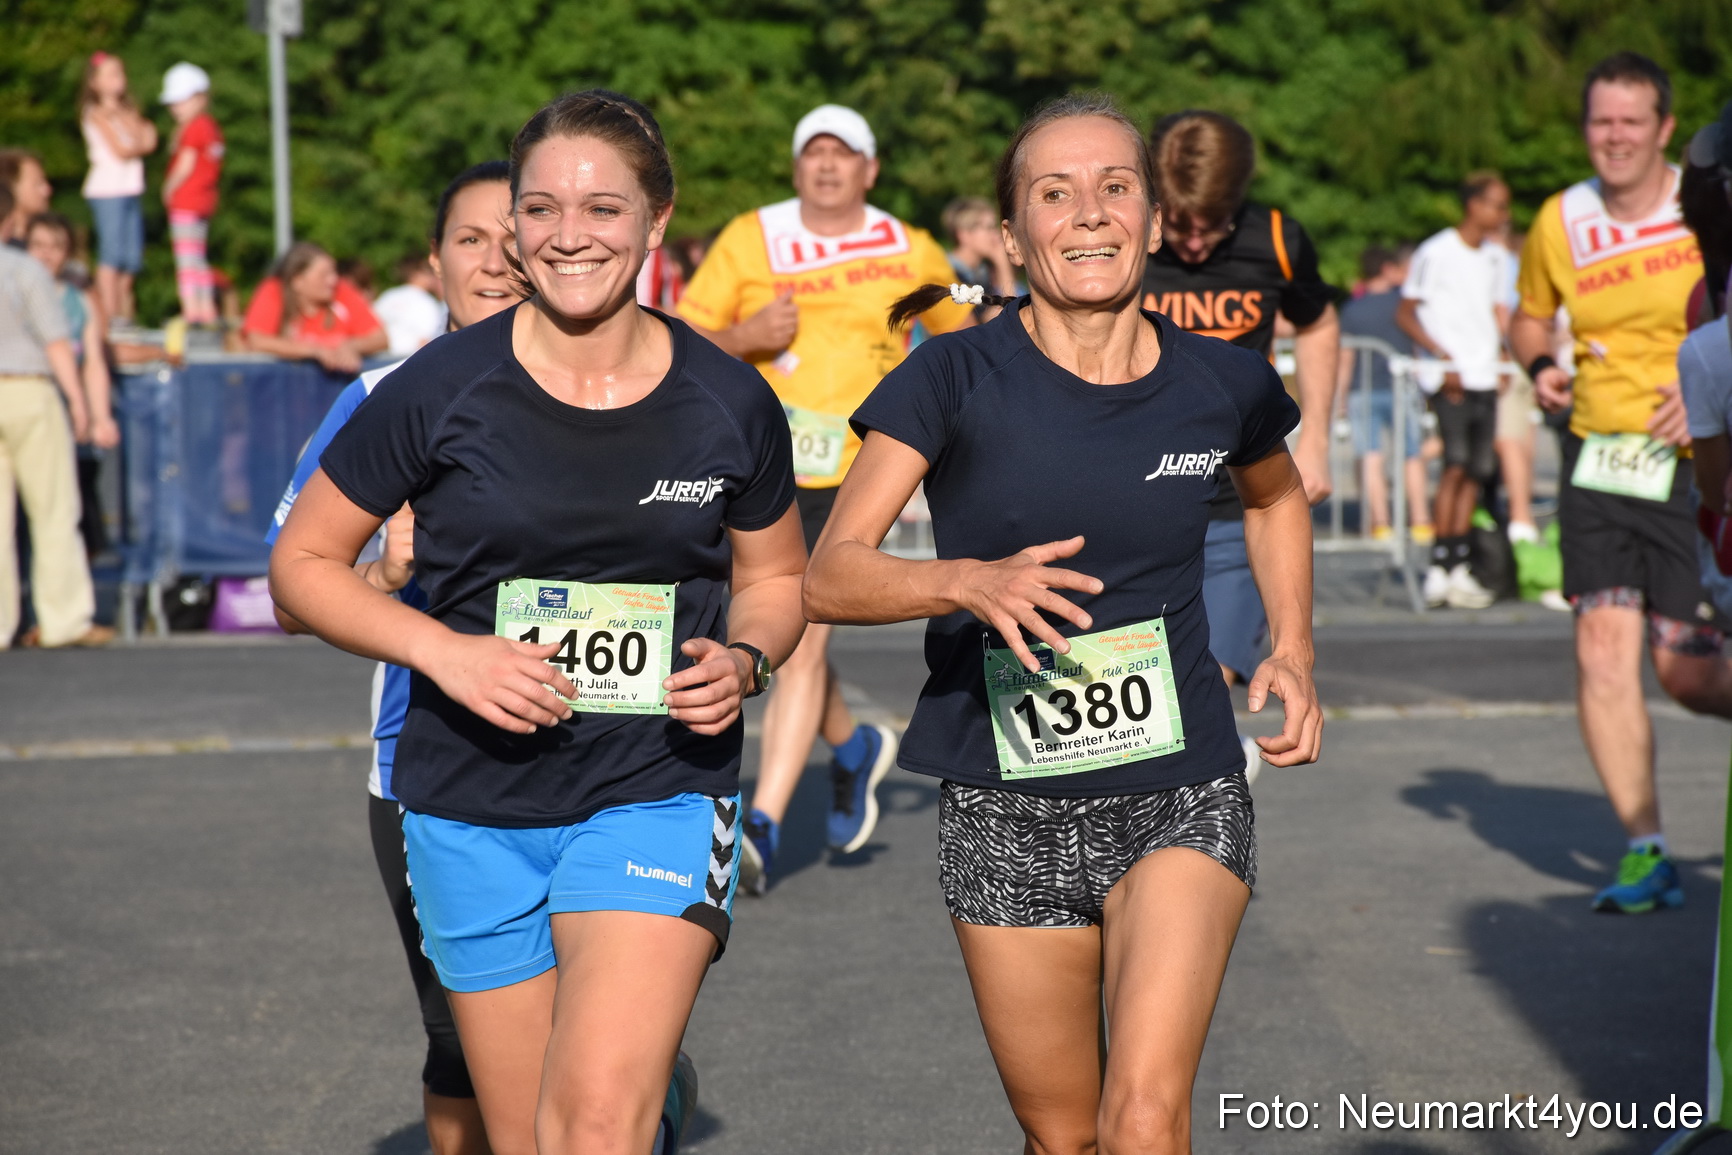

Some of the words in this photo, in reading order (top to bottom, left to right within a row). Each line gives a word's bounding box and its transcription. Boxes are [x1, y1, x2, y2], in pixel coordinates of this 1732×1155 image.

[773, 275, 836, 297] MAX
[845, 262, 915, 285] BÖGL
[1576, 264, 1633, 297] MAX
[1643, 246, 1704, 276] BÖG
[792, 430, 830, 460] 03
[1145, 453, 1210, 481] JURA
[1594, 447, 1660, 478] 1640
[638, 480, 708, 505] JURA
[524, 603, 594, 620] firmenlauf
[631, 619, 662, 630] 2019
[1012, 662, 1083, 686] firmenlauf
[1128, 656, 1159, 674] 2019
[587, 678, 618, 690] Julia
[621, 693, 629, 701] e.
[631, 693, 638, 701] V
[1014, 674, 1152, 740] 1380
[1031, 750, 1085, 765] Lebenshilfe
[1087, 741, 1133, 757] Neumarkt
[1134, 740, 1143, 748] e.
[1144, 736, 1151, 745] V
[1034, 735, 1104, 754] Bernreiter
[1108, 726, 1145, 742] Karin
[626, 860, 693, 888] hummel
